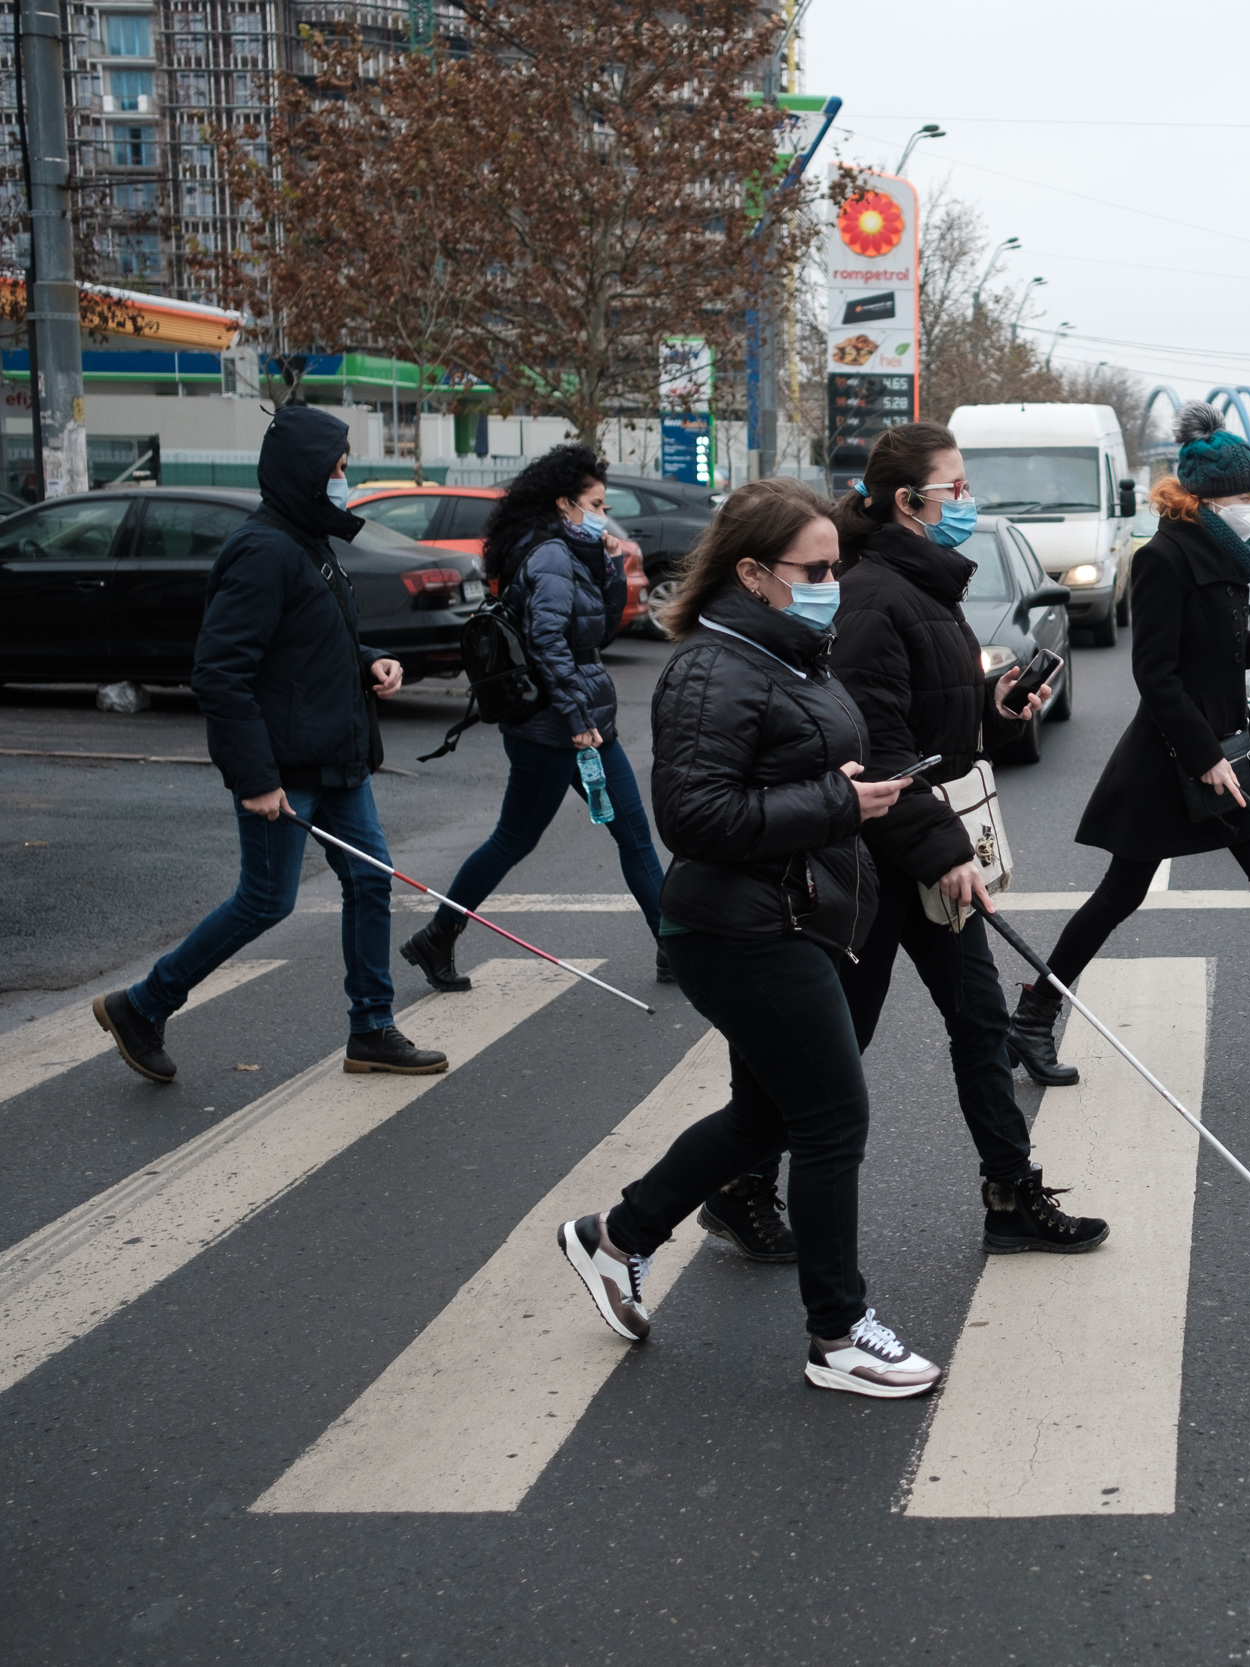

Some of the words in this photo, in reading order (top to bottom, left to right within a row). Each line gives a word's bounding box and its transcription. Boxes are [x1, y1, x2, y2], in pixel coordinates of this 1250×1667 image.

[833, 267, 909, 284] rompetrol
[882, 376, 909, 391] 4.65
[882, 396, 909, 411] 5.28
